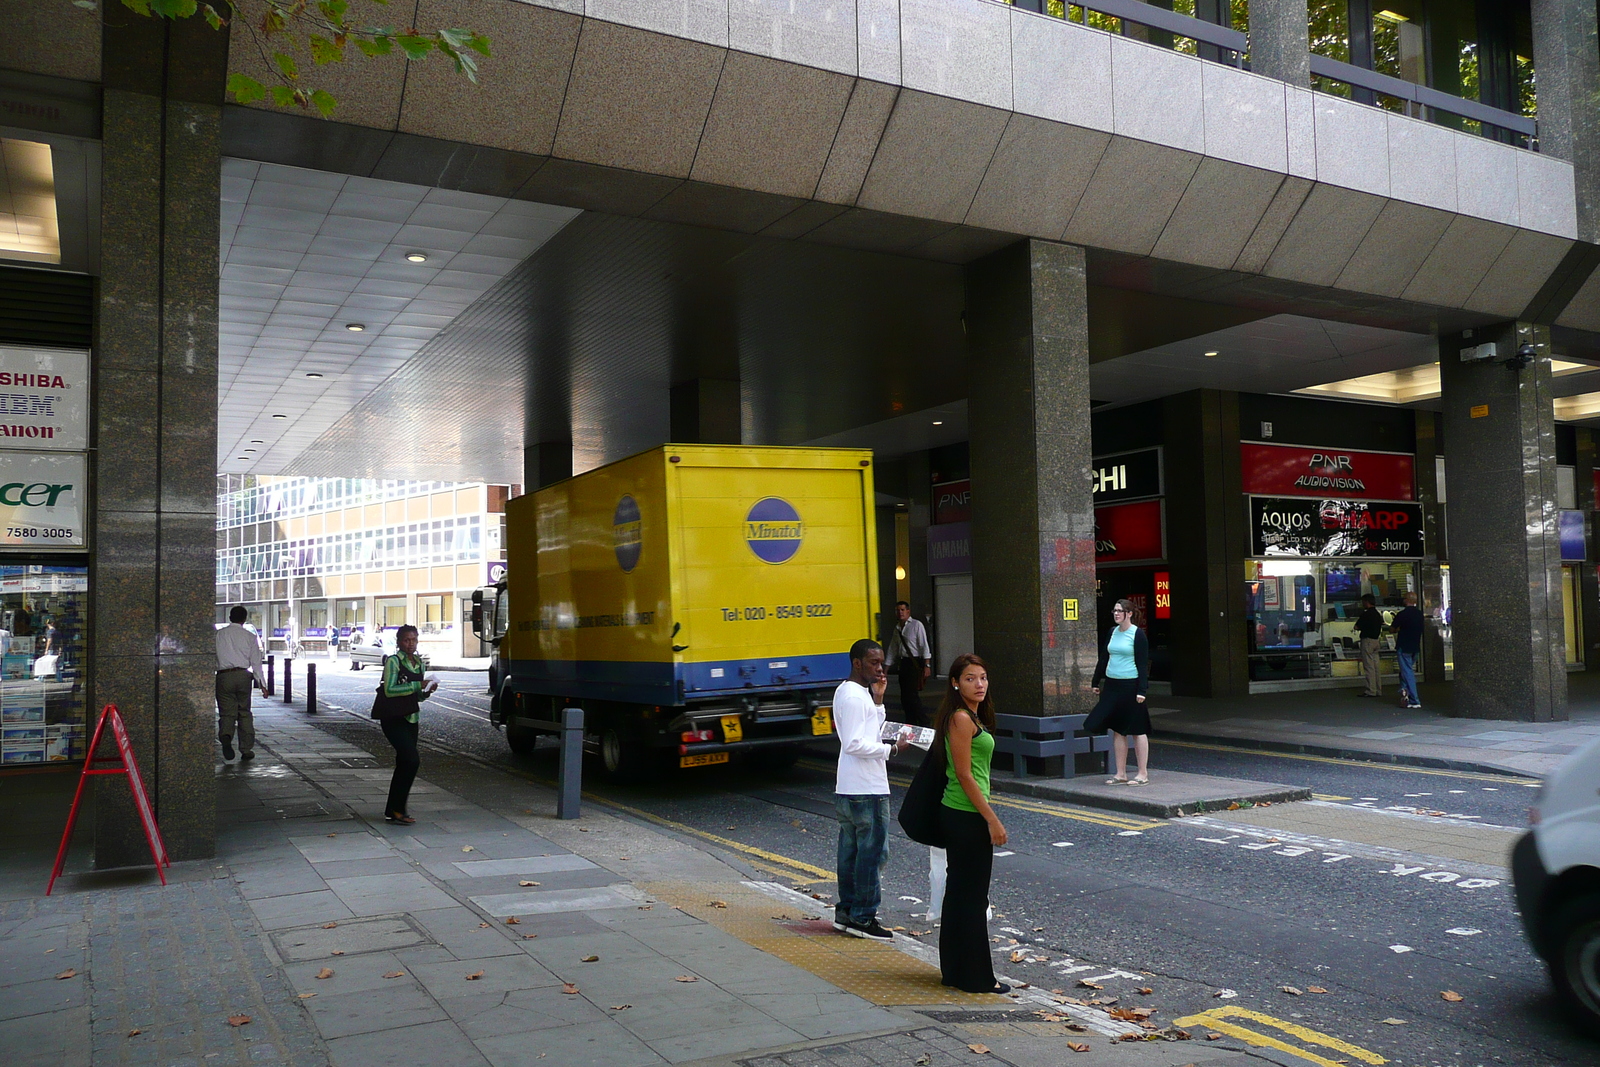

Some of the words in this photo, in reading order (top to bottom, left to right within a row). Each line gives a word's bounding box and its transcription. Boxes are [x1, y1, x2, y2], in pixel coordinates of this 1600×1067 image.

[0, 393, 55, 416] IBM
[1308, 453, 1353, 470] PNR
[1294, 475, 1366, 490] AUDIOVISION
[1260, 511, 1311, 528] AQUOS
[1321, 509, 1410, 530] SHARP
[7, 527, 38, 537] 7580
[42, 528, 73, 539] 3005
[747, 522, 802, 539] Minatol
[932, 538, 970, 559] YAMAHA
[1365, 538, 1378, 551] be
[1381, 538, 1410, 554] sharp
[1157, 581, 1169, 590] PN
[721, 608, 742, 621] Tel:
[744, 607, 766, 620] 020
[776, 605, 803, 619] 8549
[806, 604, 832, 617] 9222
